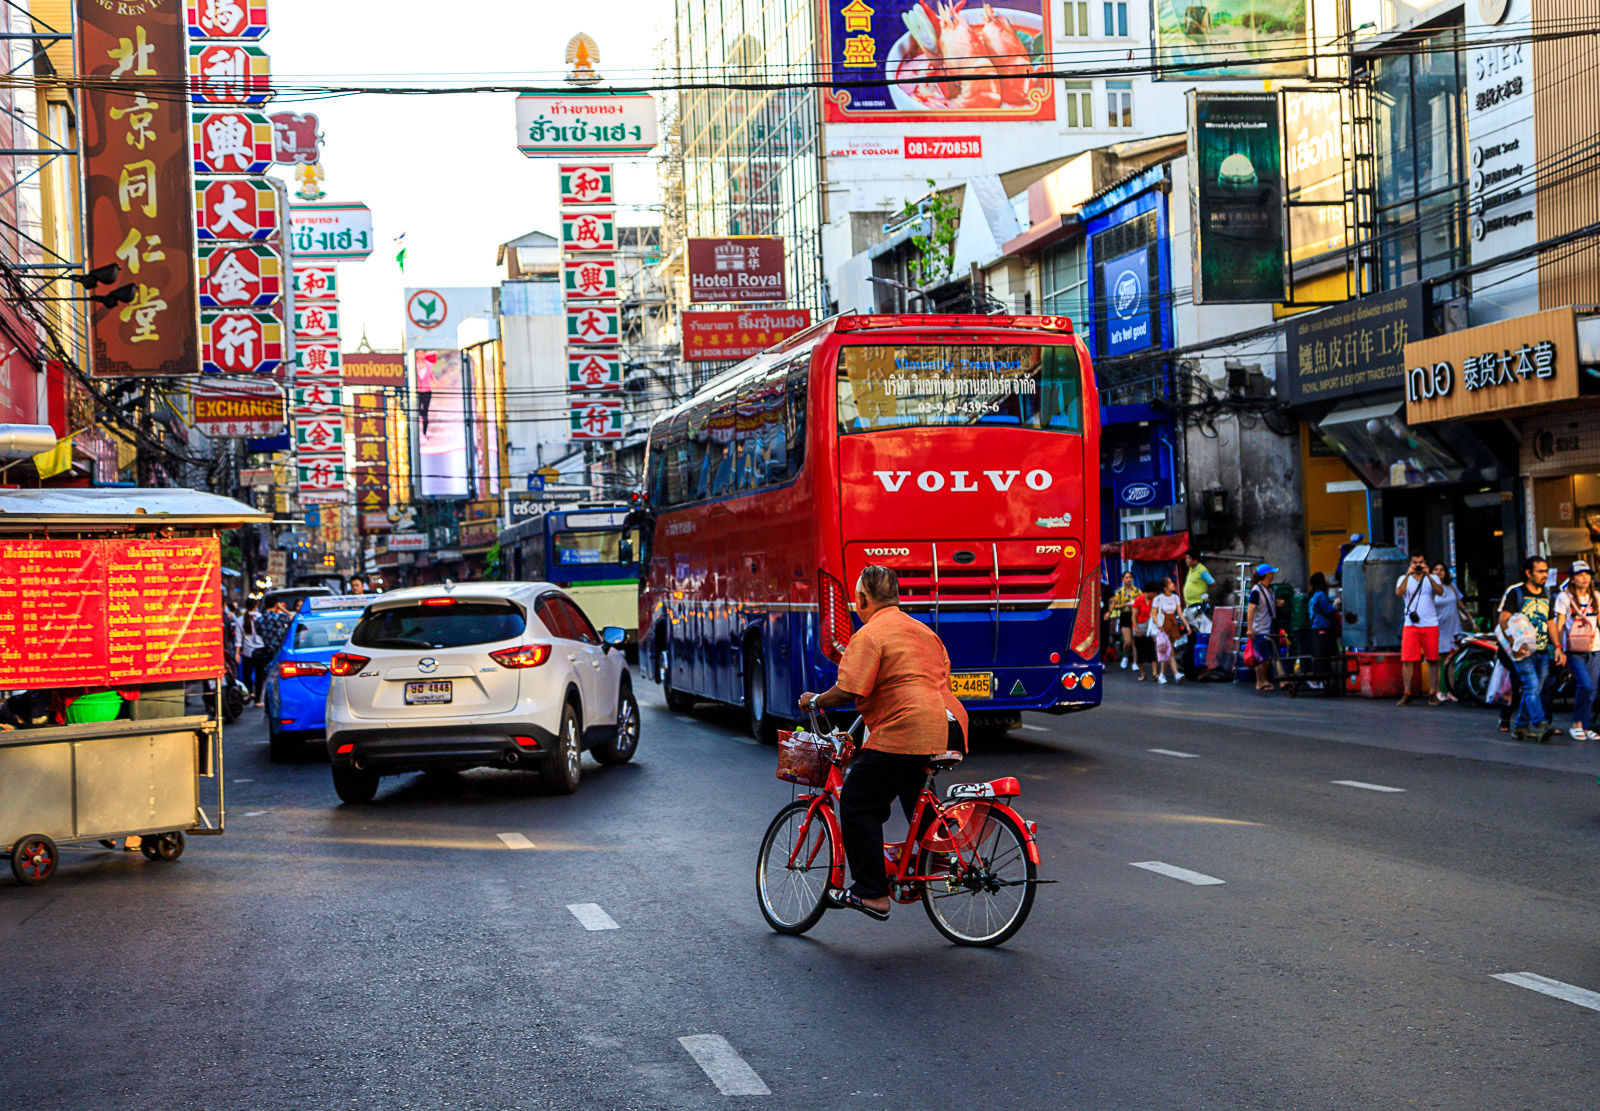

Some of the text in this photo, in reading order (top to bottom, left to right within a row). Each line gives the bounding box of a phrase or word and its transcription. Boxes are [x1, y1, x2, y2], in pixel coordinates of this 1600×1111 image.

[550, 101, 624, 115] ห้างขายทอง
[106, 25, 168, 343] 北京同仁堂
[692, 272, 782, 288] Hotel Royal
[740, 290, 782, 299] Chinatown
[959, 358, 1022, 373] Transport
[1462, 341, 1554, 391] 泰货大本营
[884, 373, 911, 396] บริษัท
[1013, 372, 1037, 395] จำกัด
[195, 399, 284, 417] EXCHANGE
[917, 401, 1000, 414] 02-941-4395-6
[873, 469, 1053, 492] VOLVO
[864, 547, 910, 556] VOLVO
[1035, 545, 1062, 554] B7R
